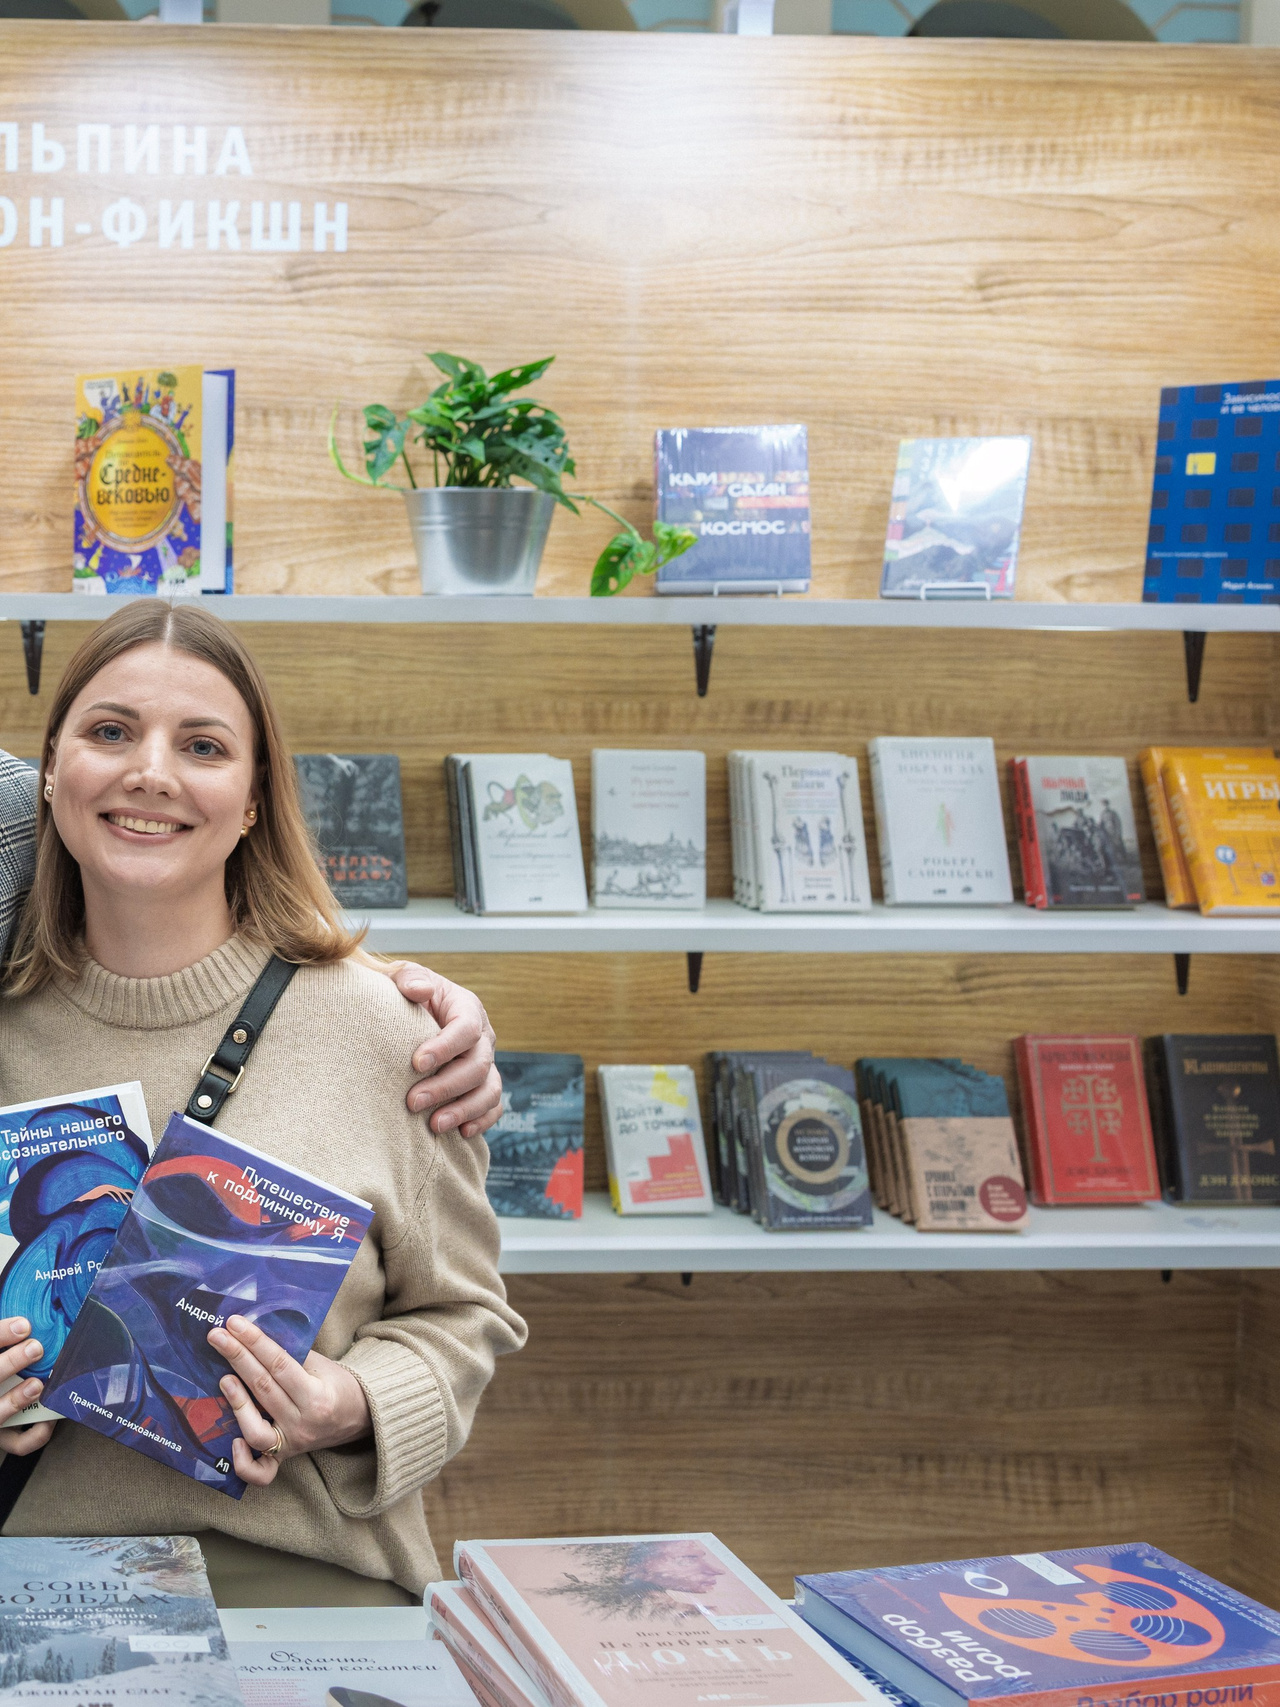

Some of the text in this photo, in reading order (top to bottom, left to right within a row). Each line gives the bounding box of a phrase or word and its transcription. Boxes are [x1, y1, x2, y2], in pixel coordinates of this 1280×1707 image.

[100, 463, 166, 489] Средне-
[97, 487, 170, 505] вековью
[700, 520, 786, 536] КОСМОС
[1204, 781, 1280, 799] ИГРЫ
[616, 1105, 663, 1121] Дойти
[1, 1114, 123, 1145] Тайны нашего
[619, 1121, 638, 1135] до
[241, 1165, 351, 1229] Путешествие
[206, 1171, 346, 1243] к подлинному Я
[34, 1263, 83, 1281] Андрей
[175, 1297, 225, 1328] Андрей
[22, 1403, 39, 1415] рия
[69, 1390, 182, 1453] Практика психоанализа
[23, 1581, 130, 1592] СОВЫ
[50, 1593, 171, 1606] ЛЬДАХ
[599, 1638, 766, 1649] Нелюбимая
[882, 1613, 993, 1683] Разбор
[270, 1650, 376, 1665] Облачно,
[596, 1645, 793, 1672] ДОЧЬ
[940, 1630, 1032, 1679] роли
[234, 1665, 333, 1674] зможны
[13, 1688, 171, 1698] ДЖОНАТАН СЛАТ
[1186, 1683, 1254, 1707] роли
